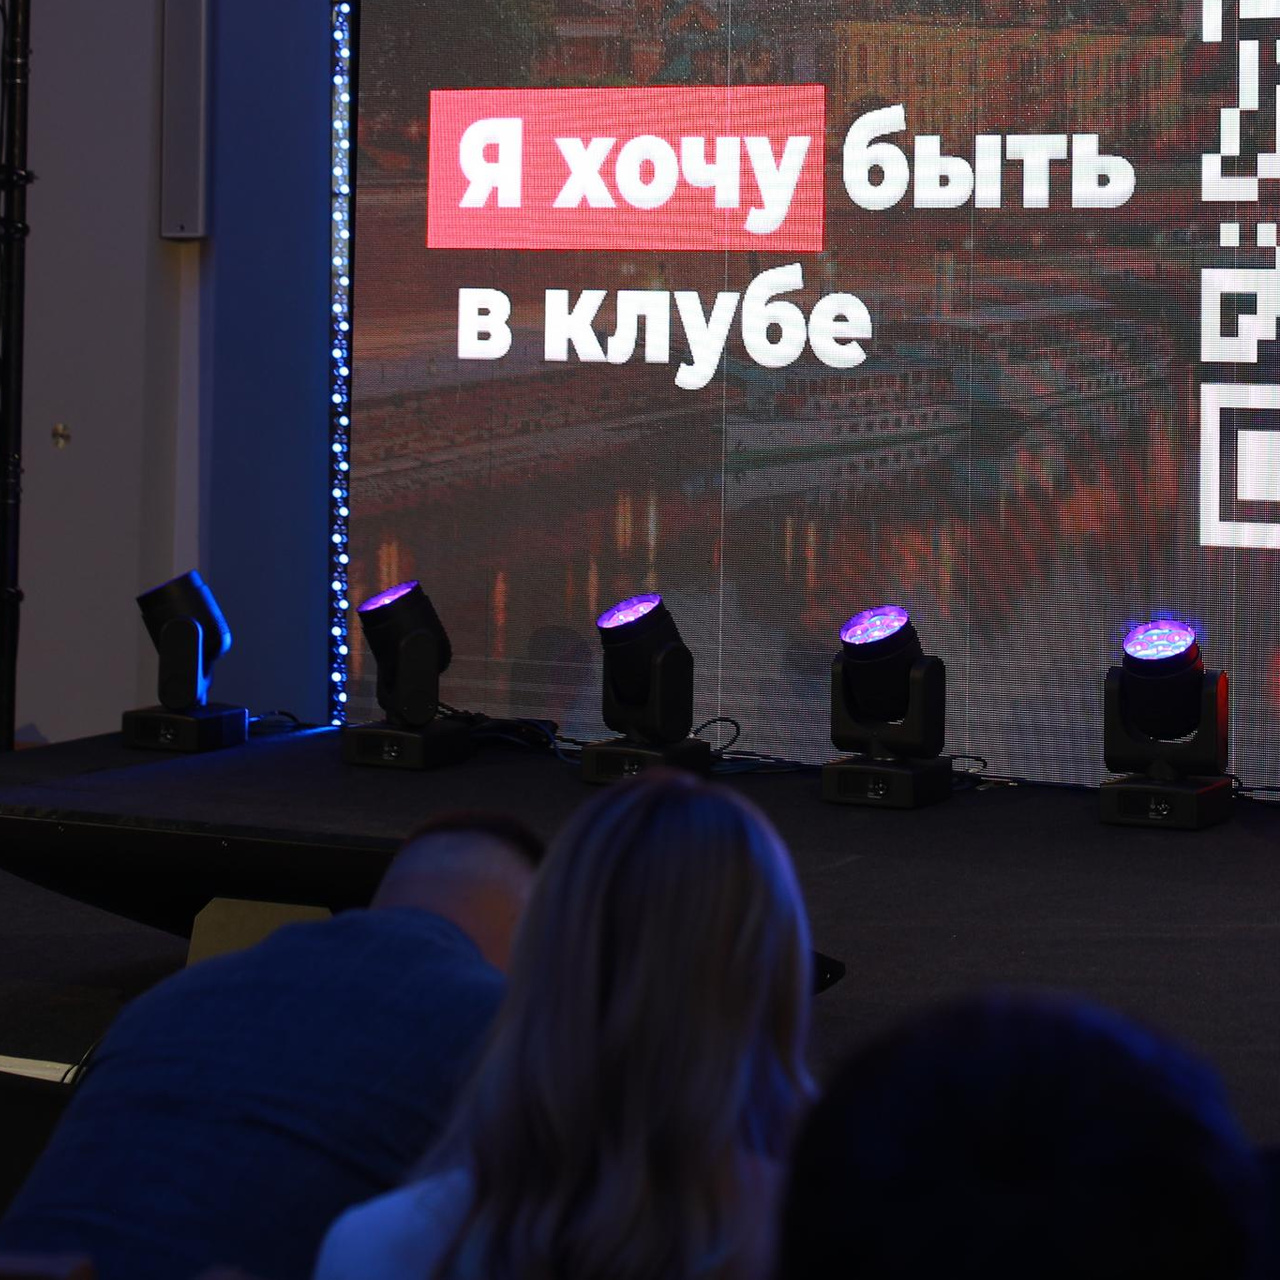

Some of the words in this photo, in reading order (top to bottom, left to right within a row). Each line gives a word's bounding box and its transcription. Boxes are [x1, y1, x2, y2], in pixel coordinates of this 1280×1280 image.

[458, 116, 524, 209] Я
[552, 134, 812, 235] хочу
[843, 104, 1136, 211] быть
[457, 288, 513, 360] в
[544, 263, 873, 391] клубе
